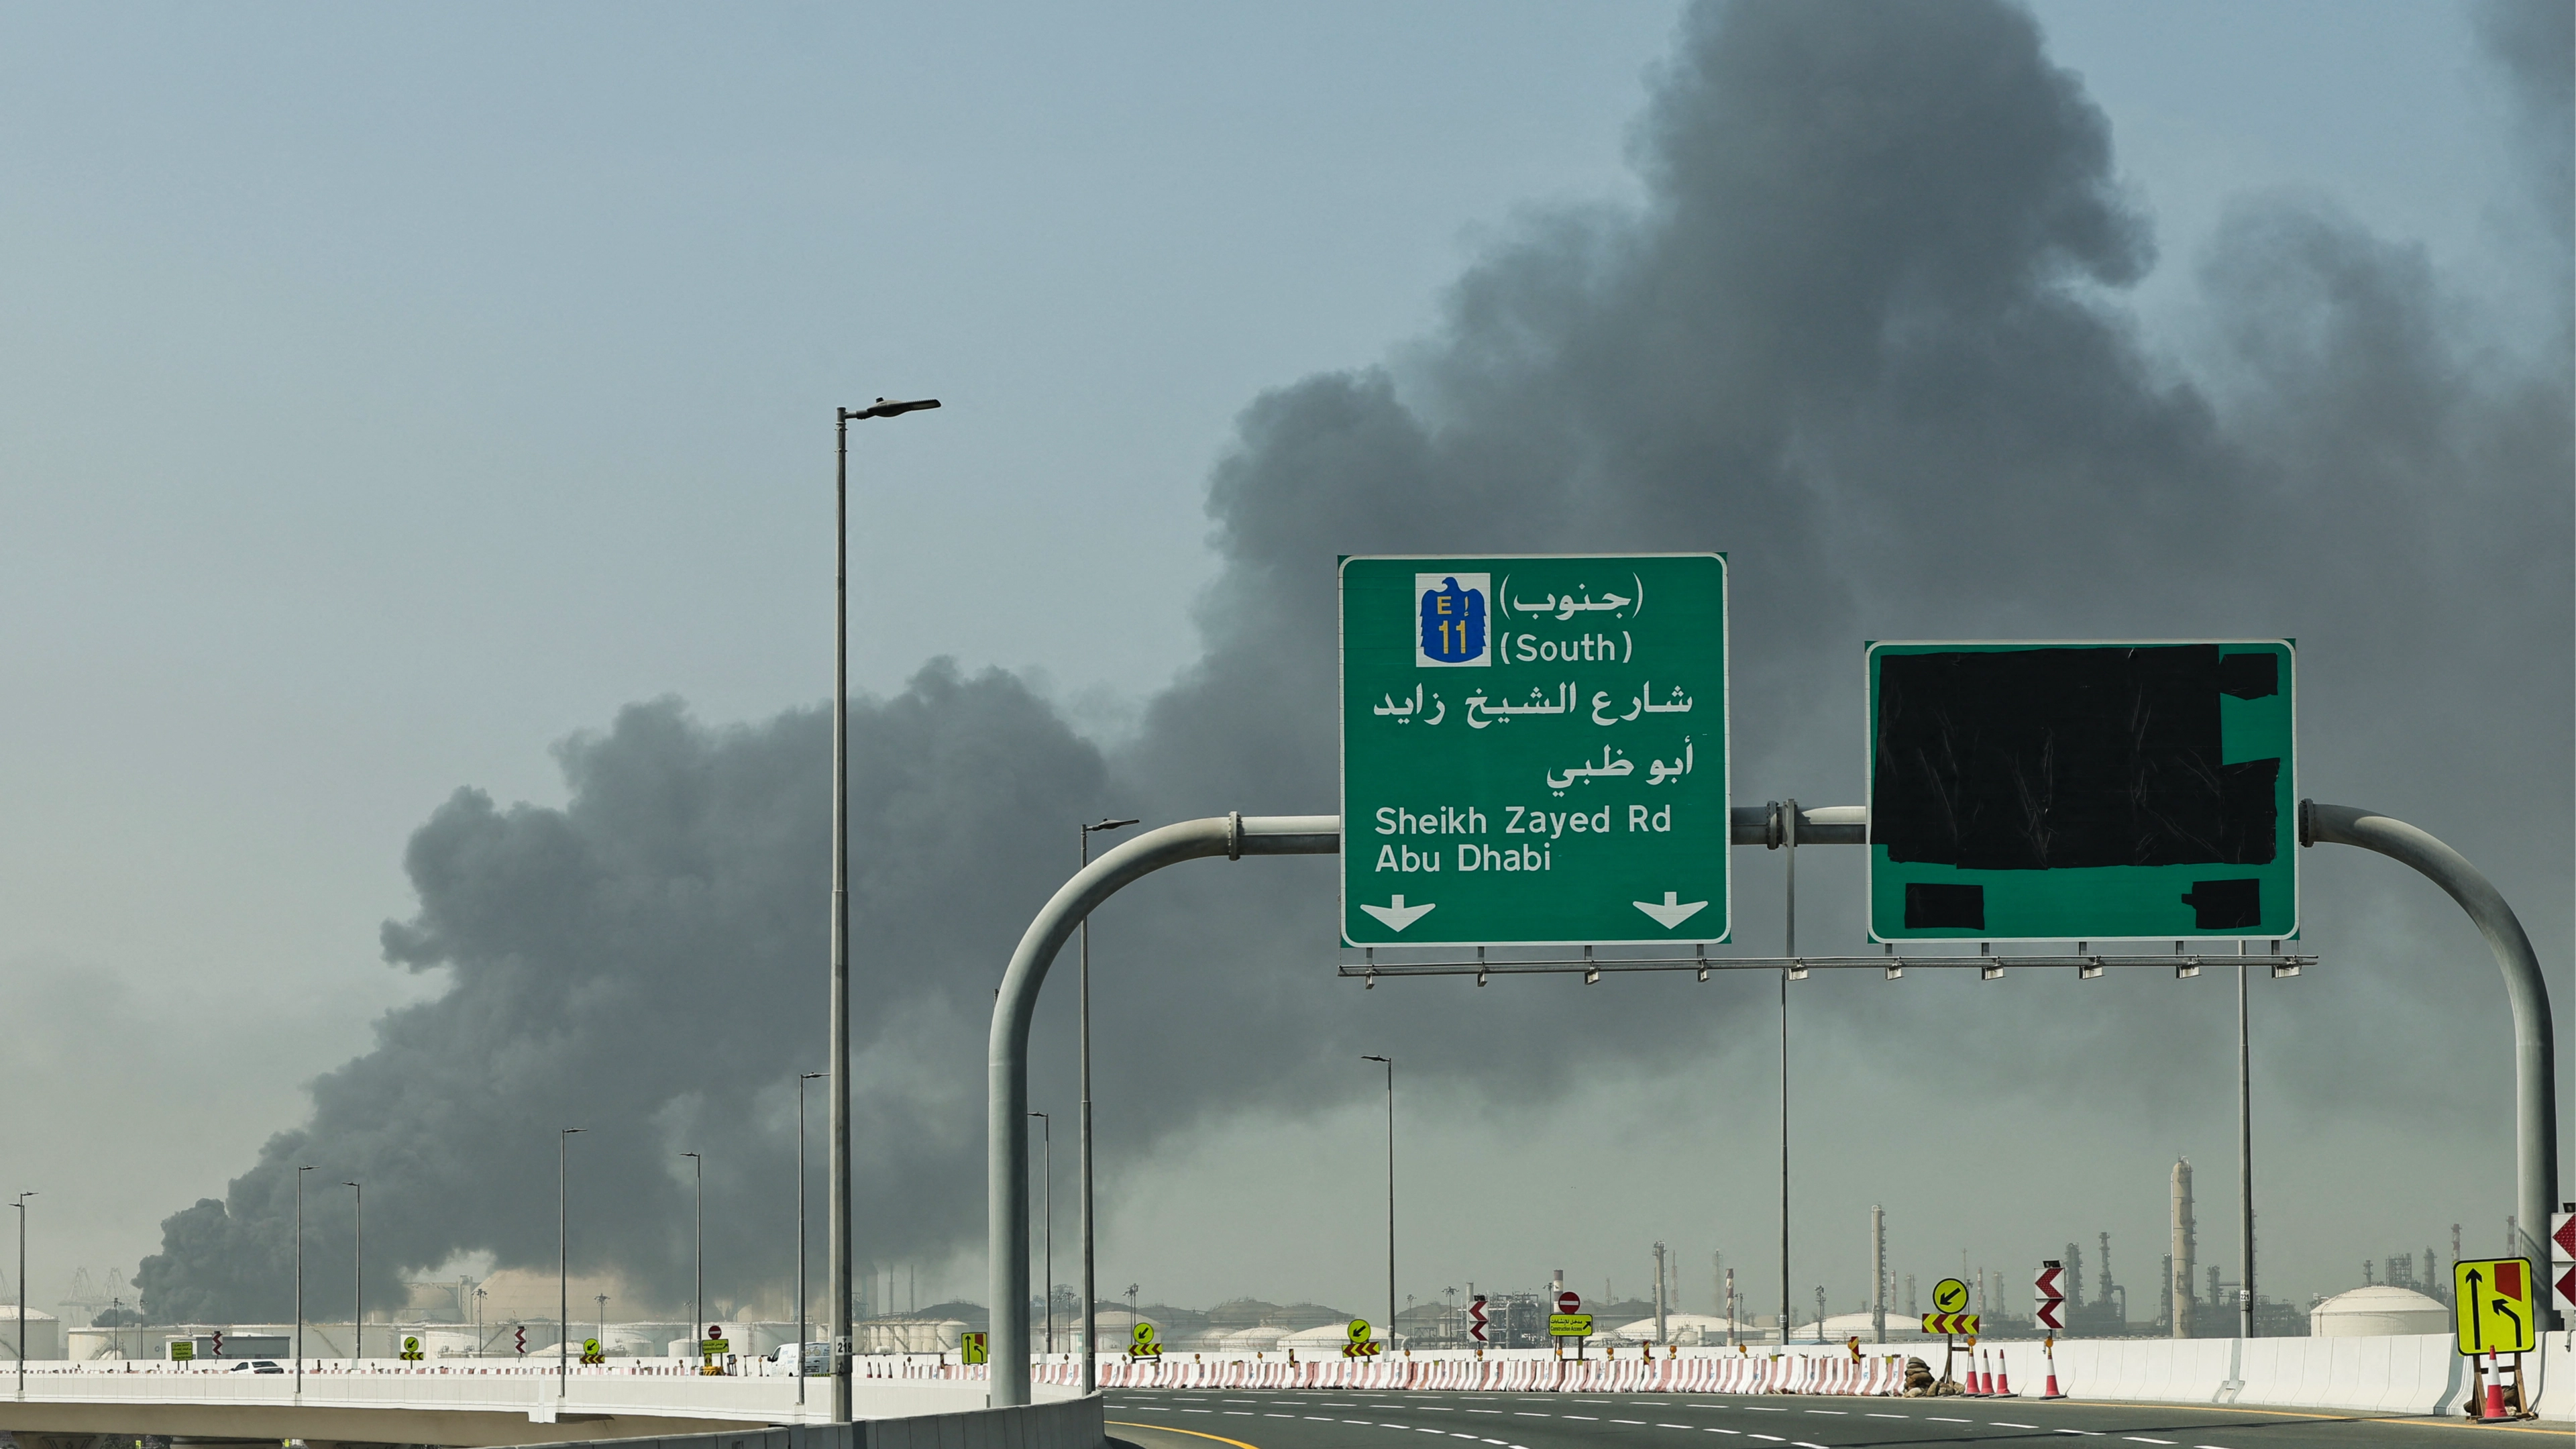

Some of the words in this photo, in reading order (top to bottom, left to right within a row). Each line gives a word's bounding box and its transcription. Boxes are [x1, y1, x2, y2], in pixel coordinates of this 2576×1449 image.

[1437, 596, 1452, 614] E
[1499, 572, 1643, 621] (جنوب)
[1438, 620, 1466, 654] 11
[1501, 631, 1632, 665] (South)
[1373, 682, 1446, 725] زايد
[1465, 681, 1576, 729] الشيخ
[1592, 680, 1693, 726] شارع
[1546, 744, 1635, 798] ظبي
[1646, 735, 1693, 786] أبو
[1375, 806, 1487, 835] Sheikh
[1505, 805, 1610, 839] Zayed
[1629, 804, 1670, 833] Rd
[1375, 845, 1440, 873] Abu
[1458, 842, 1550, 871] Dhabi
[837, 1342, 853, 1353] 218
